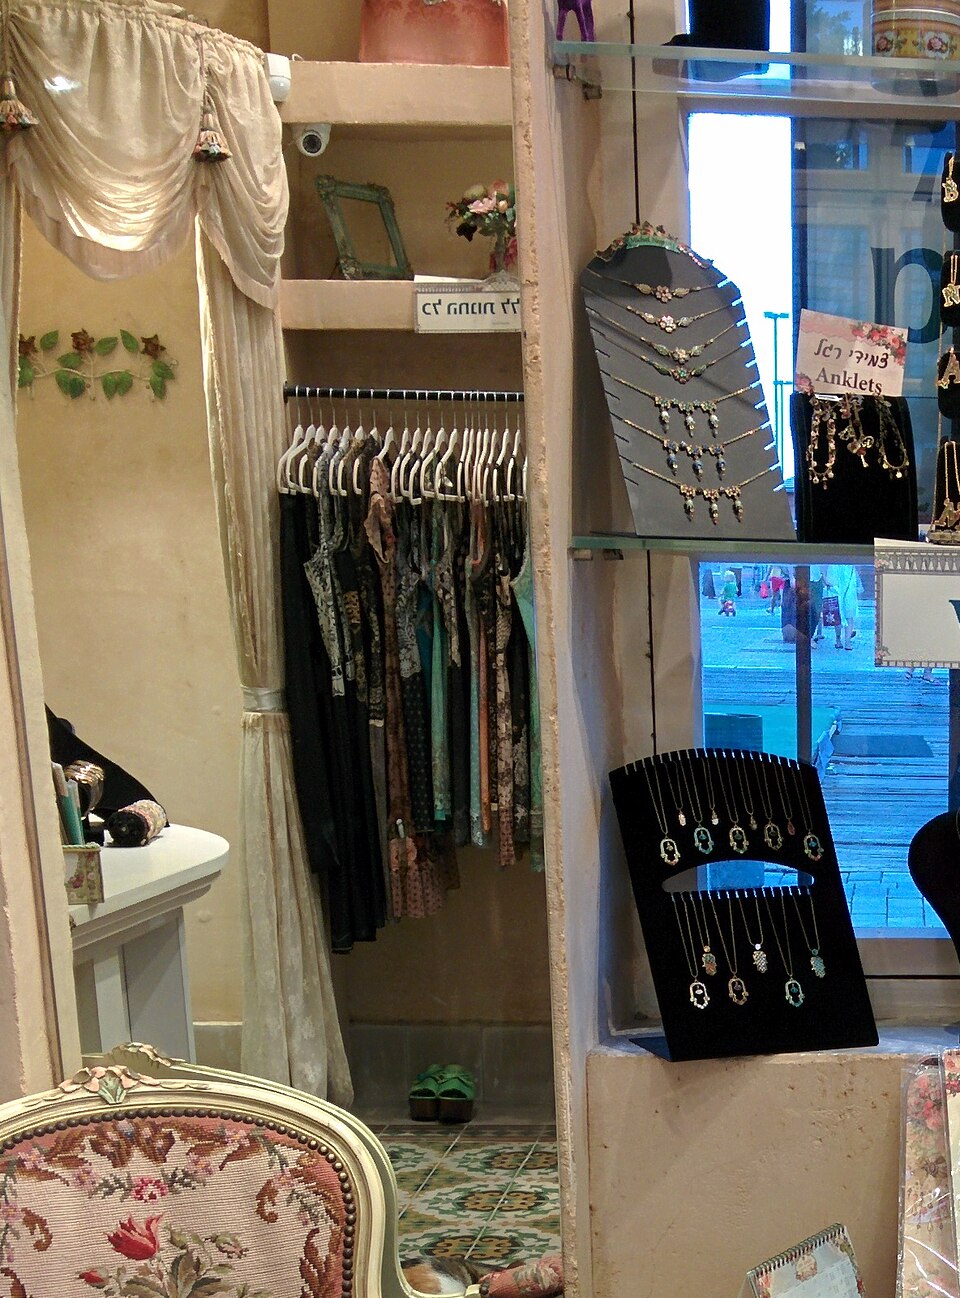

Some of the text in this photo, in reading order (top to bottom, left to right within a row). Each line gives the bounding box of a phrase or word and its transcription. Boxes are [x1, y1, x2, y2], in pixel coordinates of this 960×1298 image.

[814, 338, 889, 369] צמידי רגל
[816, 367, 884, 395] Anklets
